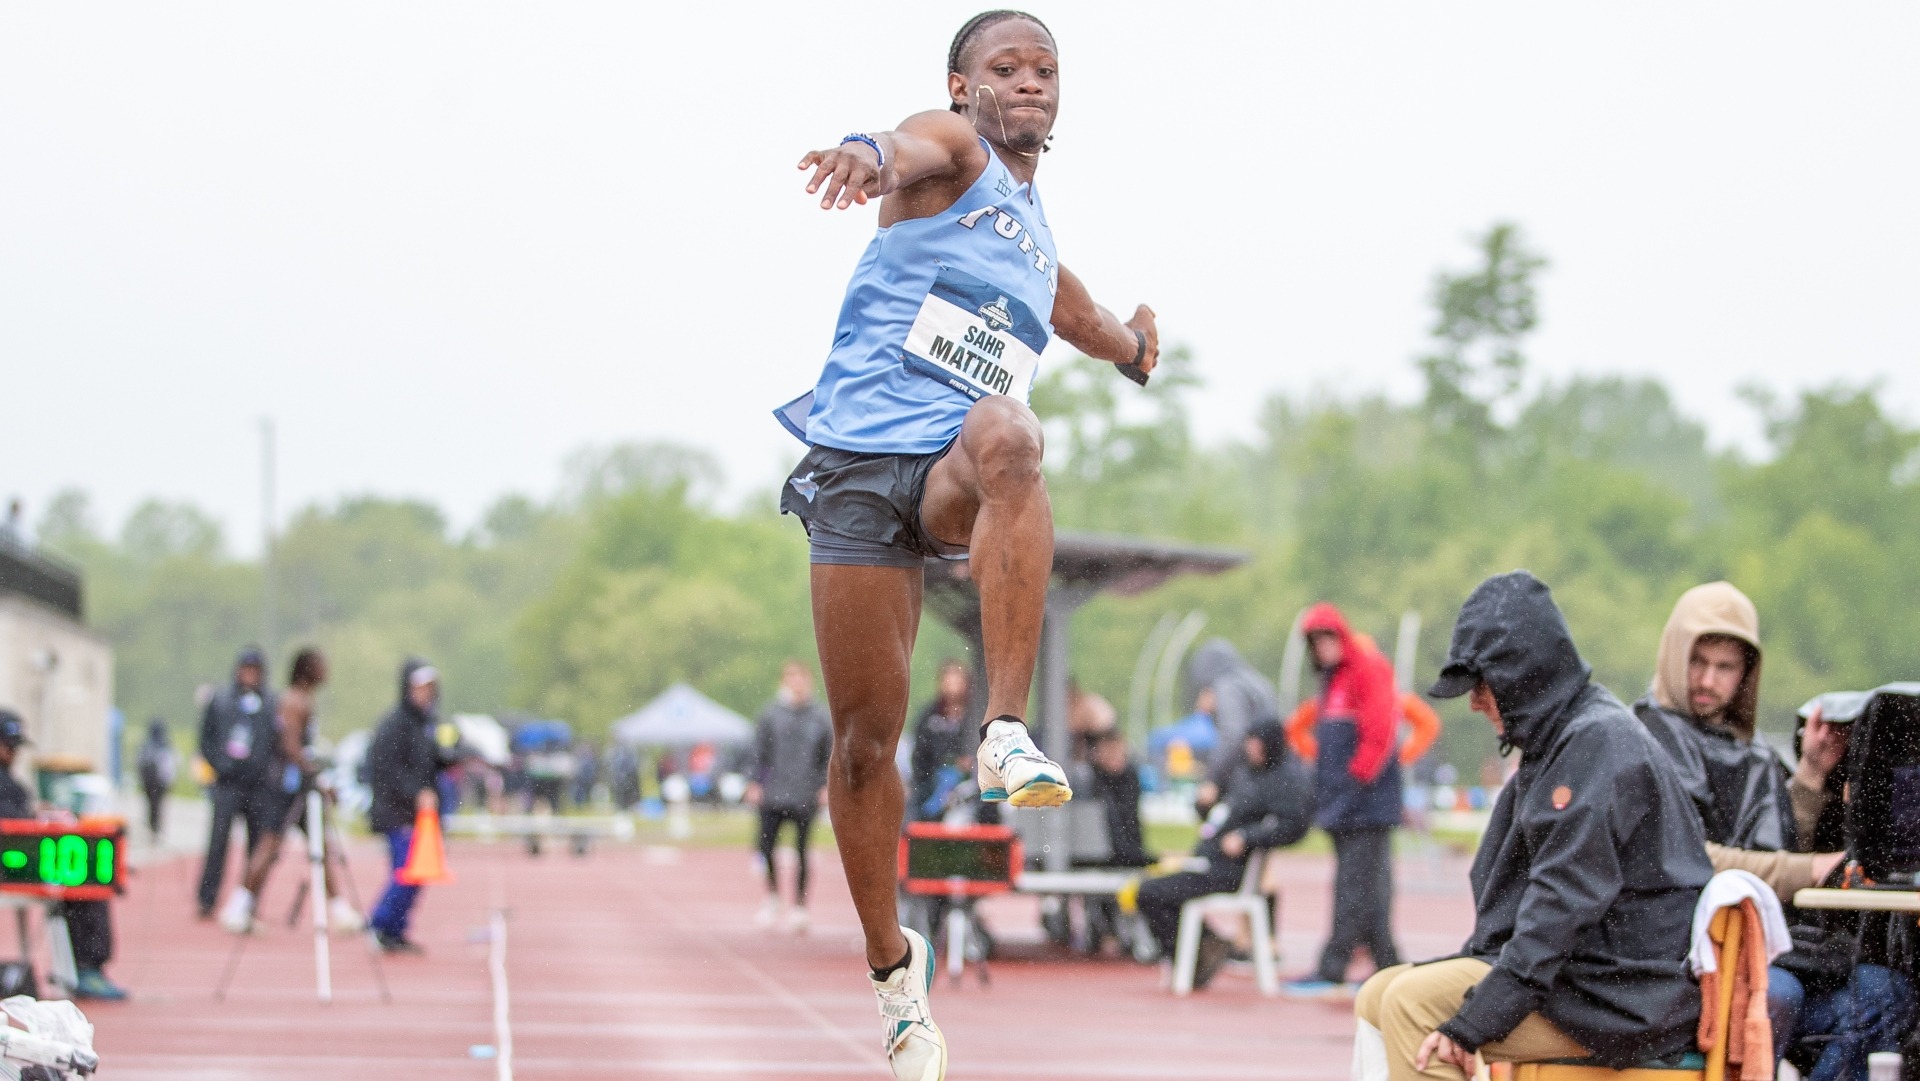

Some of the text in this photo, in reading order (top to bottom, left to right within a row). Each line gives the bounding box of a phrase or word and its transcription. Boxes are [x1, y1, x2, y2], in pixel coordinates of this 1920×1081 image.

[957, 205, 1058, 297] TUFTS
[928, 335, 1014, 396] MATTURI
[963, 325, 1006, 359] SAHR
[882, 1002, 914, 1018] NIKE
